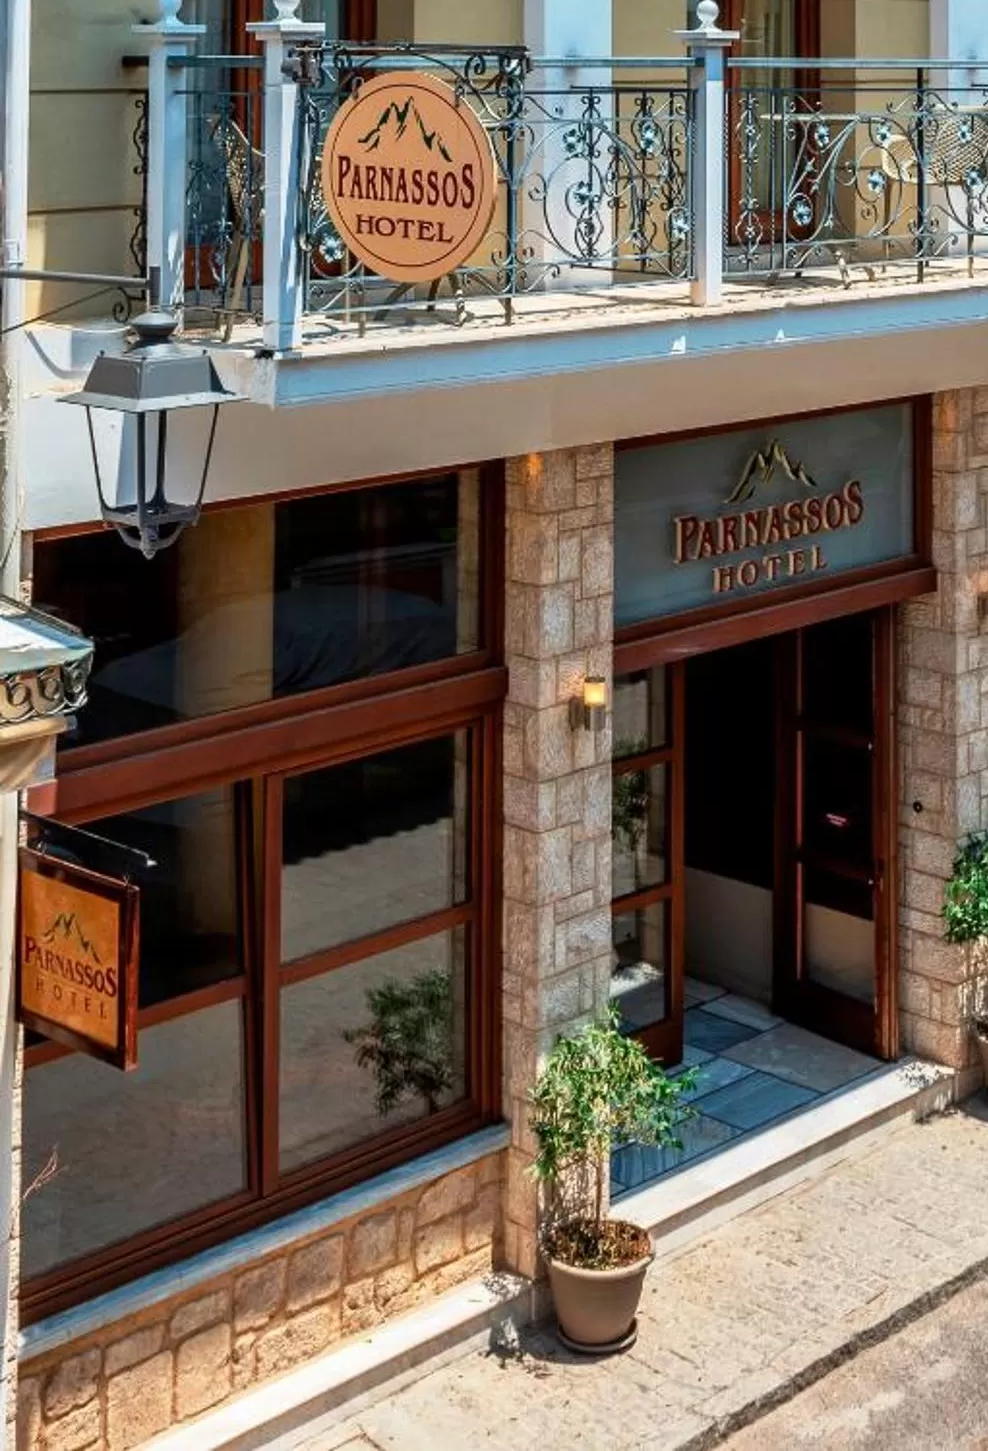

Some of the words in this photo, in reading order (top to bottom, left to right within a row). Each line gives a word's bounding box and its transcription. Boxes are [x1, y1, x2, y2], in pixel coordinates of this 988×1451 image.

[337, 155, 475, 210] PARNASSOS
[355, 213, 455, 244] HOTEL
[673, 480, 865, 564] PARNASSOS
[711, 544, 829, 593] HOTEL
[24, 935, 118, 998] PARNASSOS
[36, 976, 108, 1021] HOTEL
